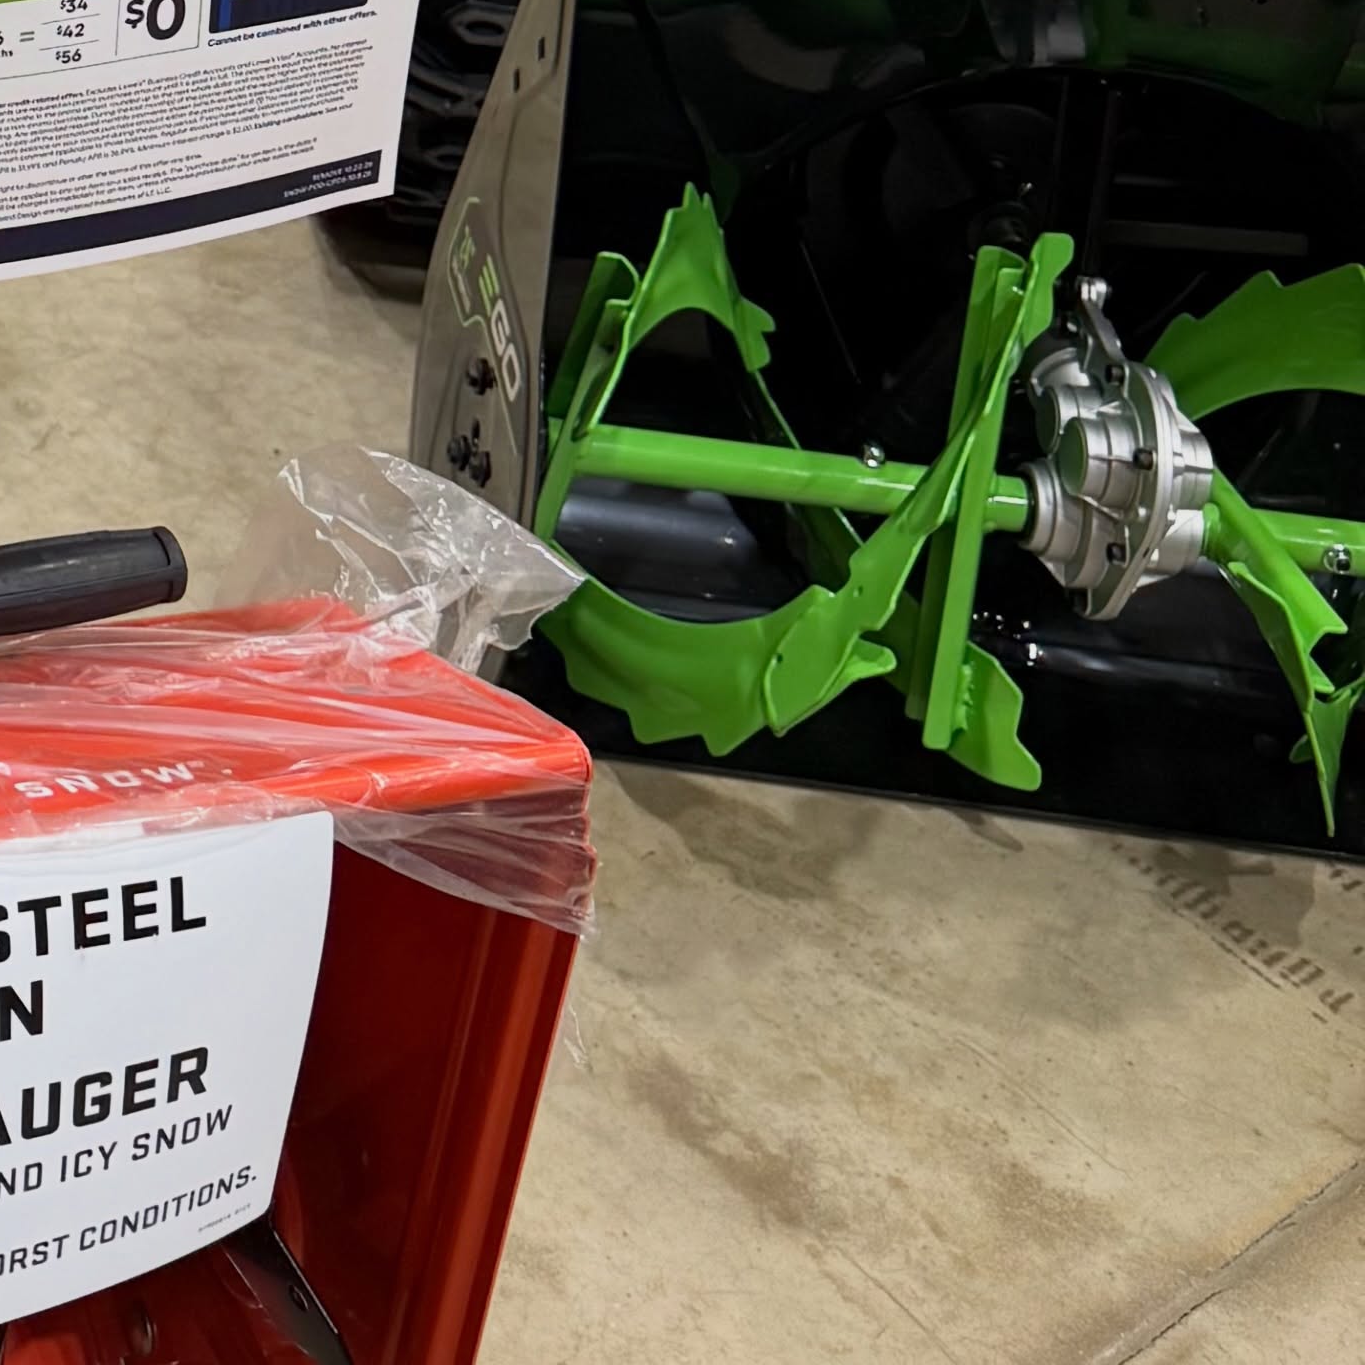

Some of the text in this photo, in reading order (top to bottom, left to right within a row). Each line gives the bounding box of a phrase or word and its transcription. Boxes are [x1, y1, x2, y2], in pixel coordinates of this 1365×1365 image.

[55, 49, 82, 64] $56
[57, 23, 85, 38] $42
[208, 10, 377, 47] Cannot be combined with other offers.
[478, 253, 520, 402] EGO
[60, 1141, 120, 1183] ICY
[131, 1104, 234, 1164] SNOW
[79, 1165, 258, 1253] CONDITIONS.
